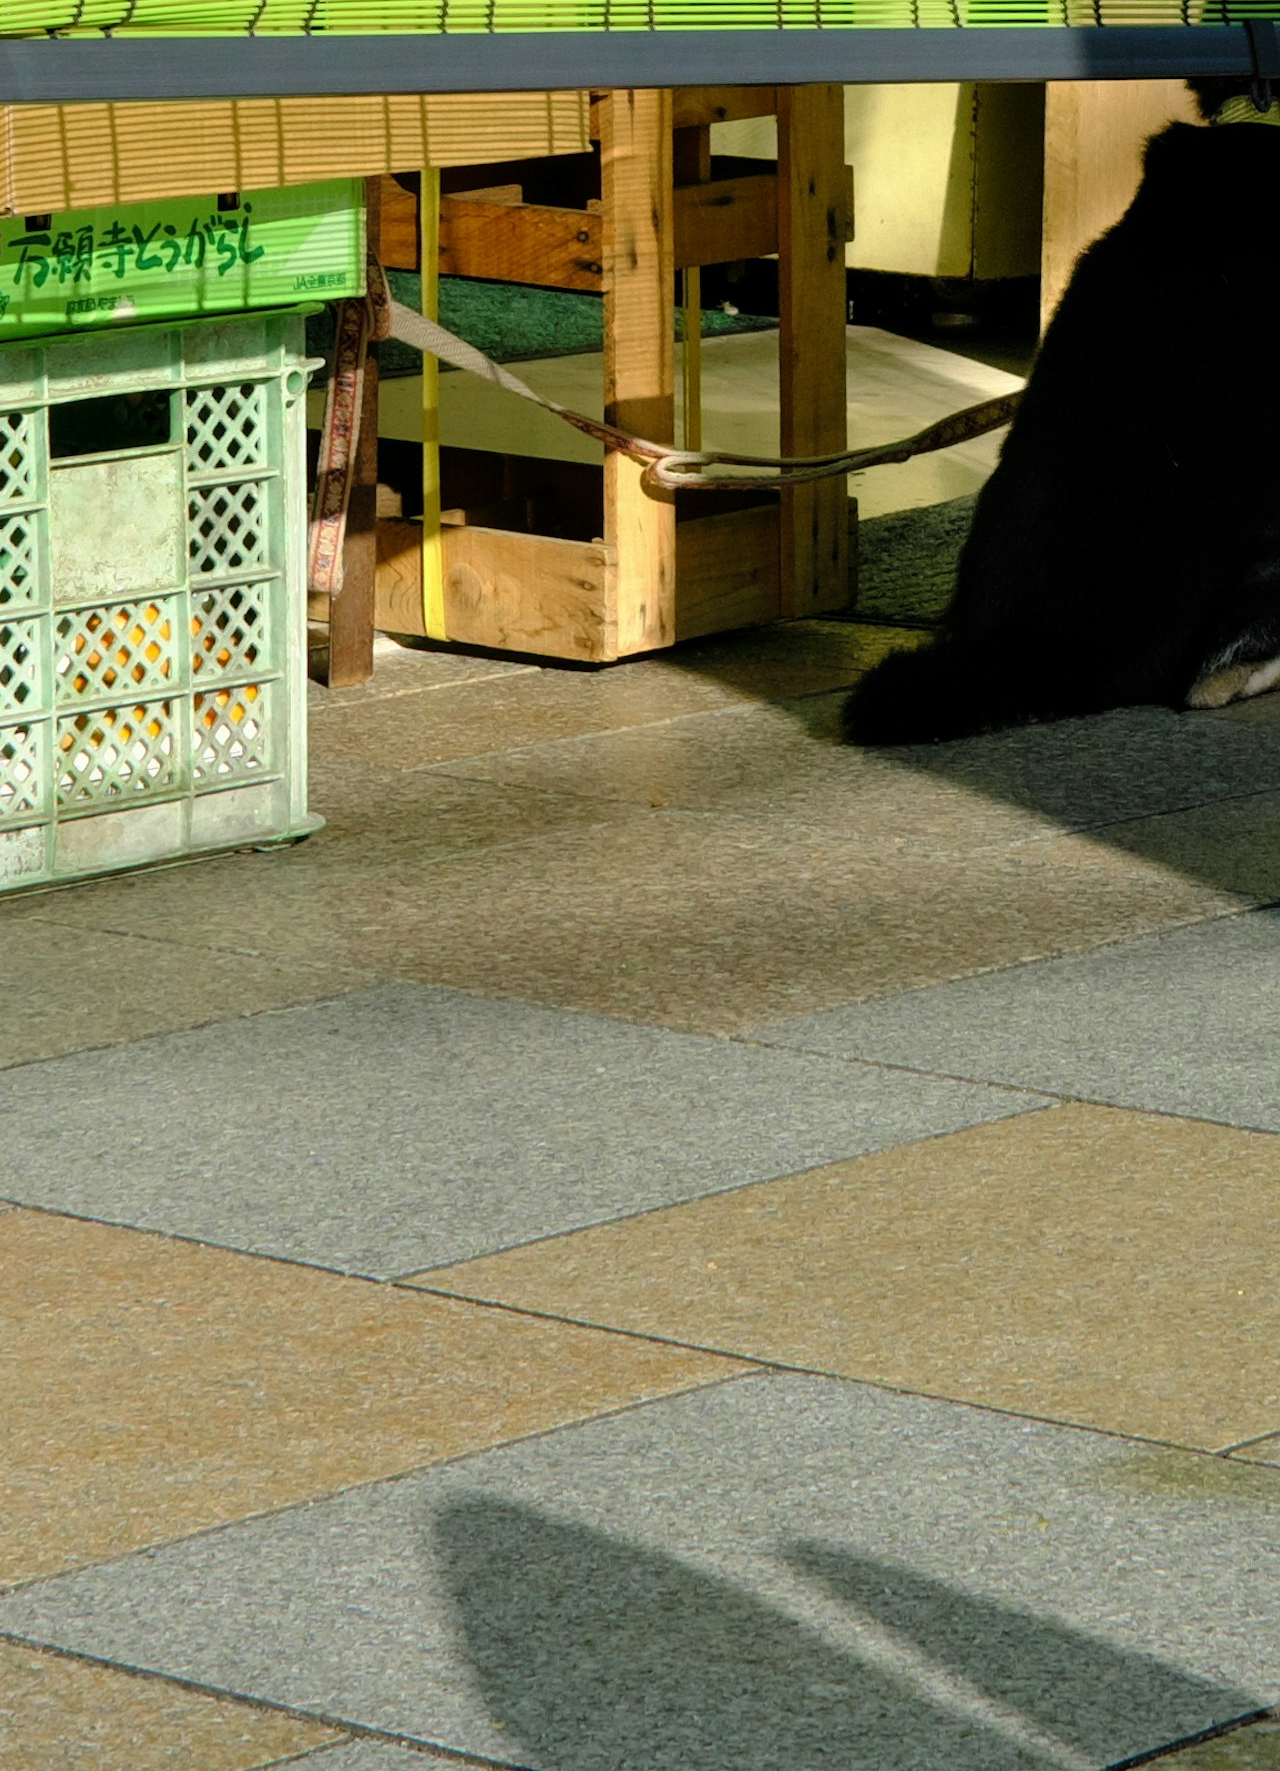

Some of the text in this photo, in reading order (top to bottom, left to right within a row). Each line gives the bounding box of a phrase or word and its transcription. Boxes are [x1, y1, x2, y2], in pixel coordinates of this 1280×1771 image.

[6, 202, 265, 290] 万願寺とうがらし
